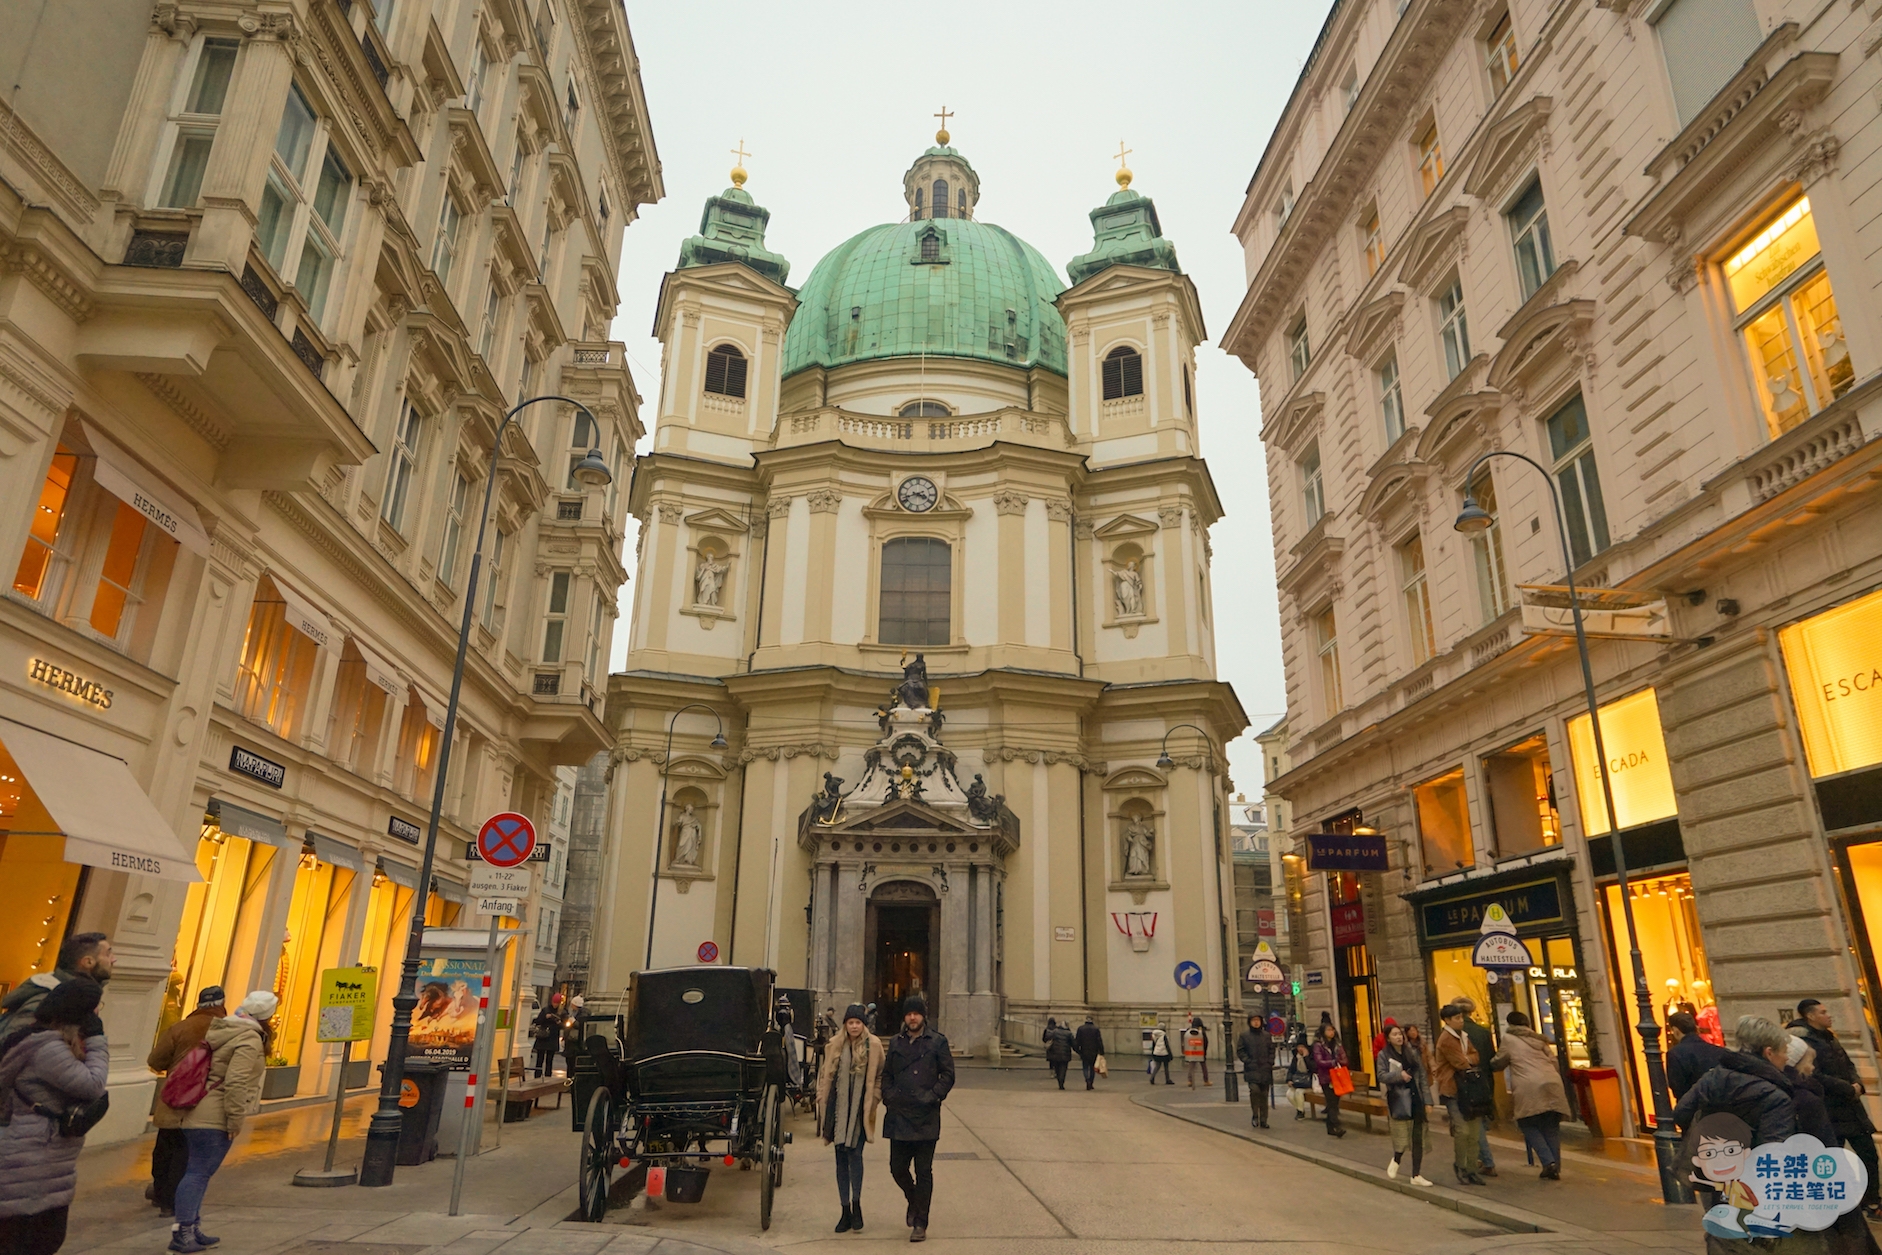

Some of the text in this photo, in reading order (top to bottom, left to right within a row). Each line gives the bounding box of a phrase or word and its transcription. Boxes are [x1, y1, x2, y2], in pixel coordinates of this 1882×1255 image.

[236, 750, 284, 784] NAPAPIJRI
[1593, 749, 1649, 780] ECADA
[1328, 849, 1379, 857] PARFUM
[472, 882, 499, 892] ausgen.
[506, 884, 528, 892] Fiaker
[1447, 910, 1458, 921] LE
[1491, 907, 1501, 919] H
[1485, 936, 1519, 950] AUTOBUS
[1480, 955, 1526, 963] HALTESTELLE
[1255, 962, 1276, 971] AUTOBUS
[329, 991, 366, 1000] FIAKER
